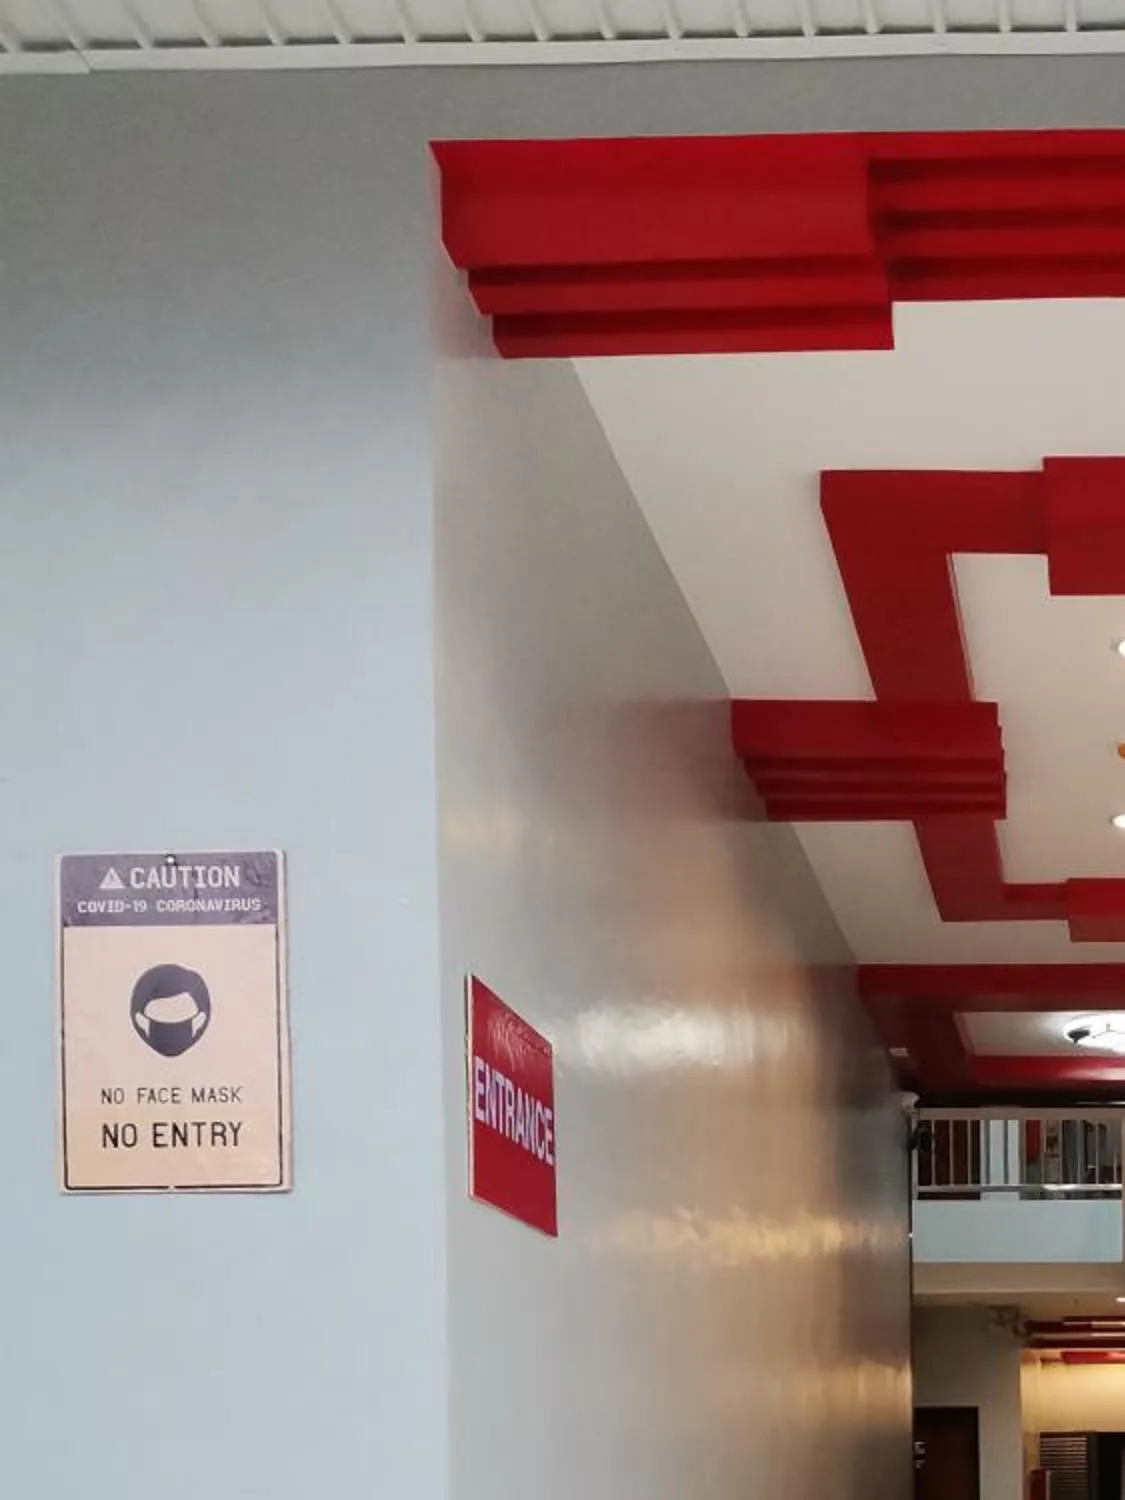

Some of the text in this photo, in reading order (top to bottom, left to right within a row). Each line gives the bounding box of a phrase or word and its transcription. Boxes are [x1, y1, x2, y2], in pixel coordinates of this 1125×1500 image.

[130, 865, 241, 889] CAUTION
[77, 898, 262, 913] COVID-19 CORONAVIRUS
[101, 1086, 242, 1105] NO FACE MASK
[474, 1055, 554, 1166] ENTRANCE
[102, 1122, 243, 1149] NO ENTRY
